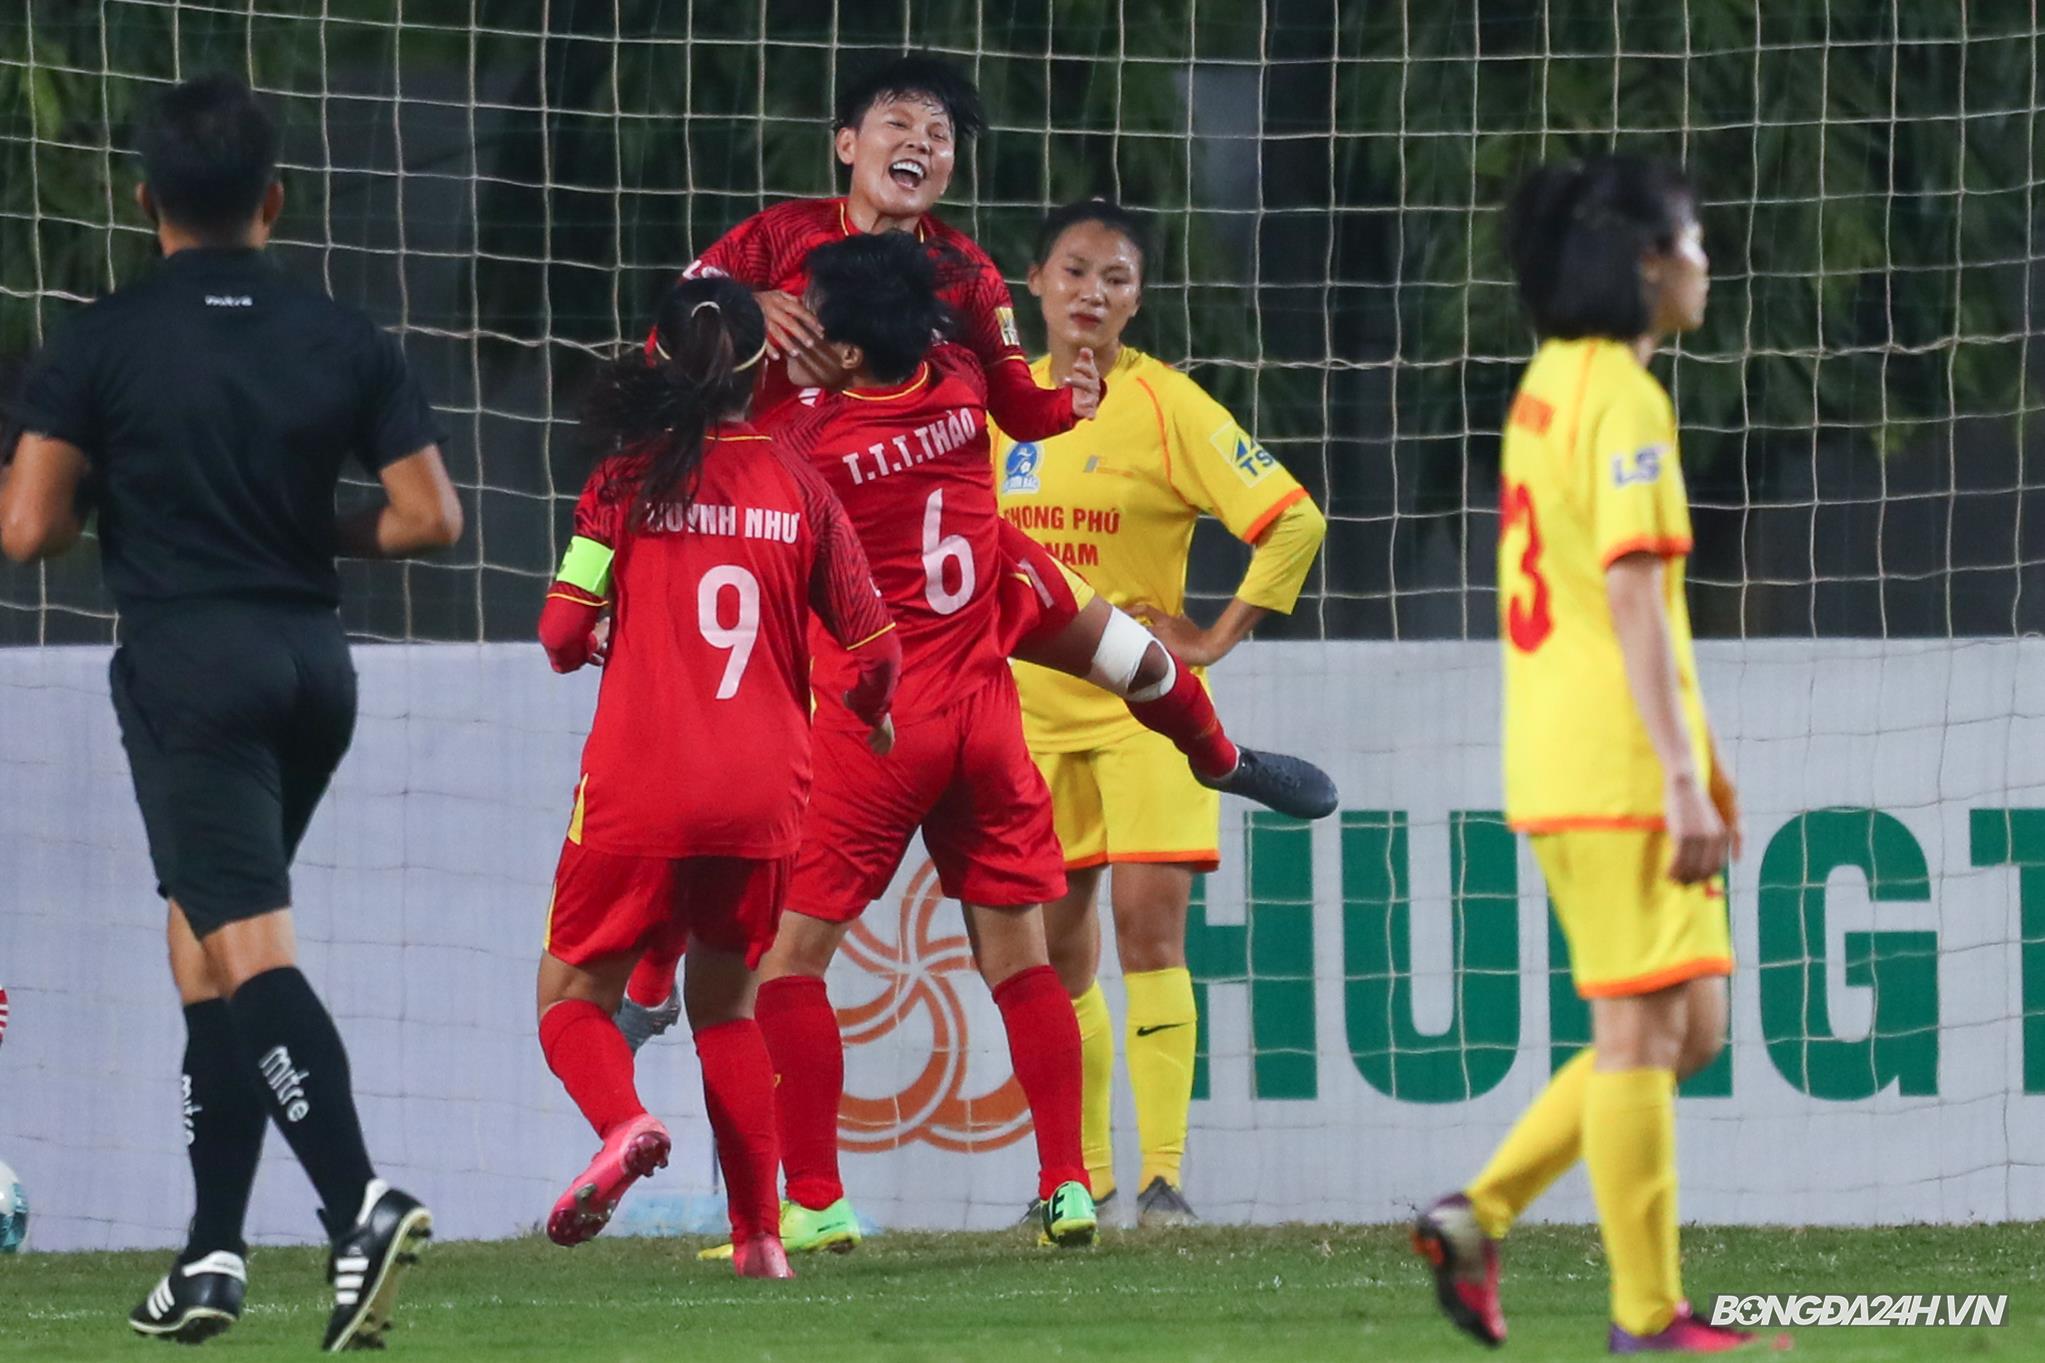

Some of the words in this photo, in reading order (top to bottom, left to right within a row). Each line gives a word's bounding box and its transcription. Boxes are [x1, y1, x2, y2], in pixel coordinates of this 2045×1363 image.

[745, 507, 801, 544] NHƯ
[922, 487, 976, 616] 6
[1073, 507, 1121, 535] PHÚ
[698, 564, 760, 699] 9
[1188, 806, 2045, 1101] HUG
[259, 1046, 310, 1122] mitre
